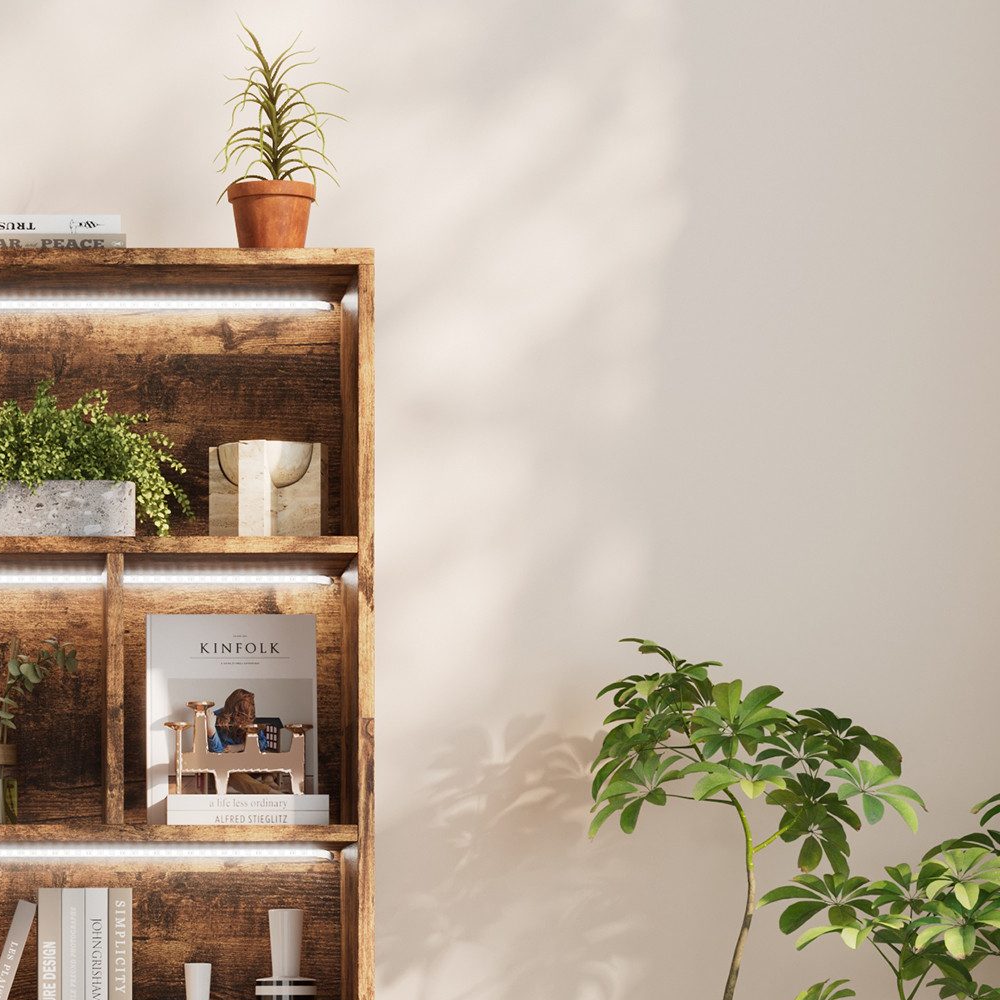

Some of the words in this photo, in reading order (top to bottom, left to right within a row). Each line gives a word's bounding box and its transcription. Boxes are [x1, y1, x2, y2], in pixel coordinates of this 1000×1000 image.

[40, 238, 105, 248] PEACE
[200, 642, 280, 654] KINFOLK
[217, 798, 231, 808] life
[233, 799, 248, 808] less
[250, 798, 288, 810] ordinary
[215, 815, 246, 823] ALFRED
[248, 814, 288, 823] STIEGLITZ
[90, 918, 102, 949] JOHN
[8, 941, 19, 960] LES
[115, 900, 125, 994] SIMPLICITY
[43, 941, 56, 980] DESIGN
